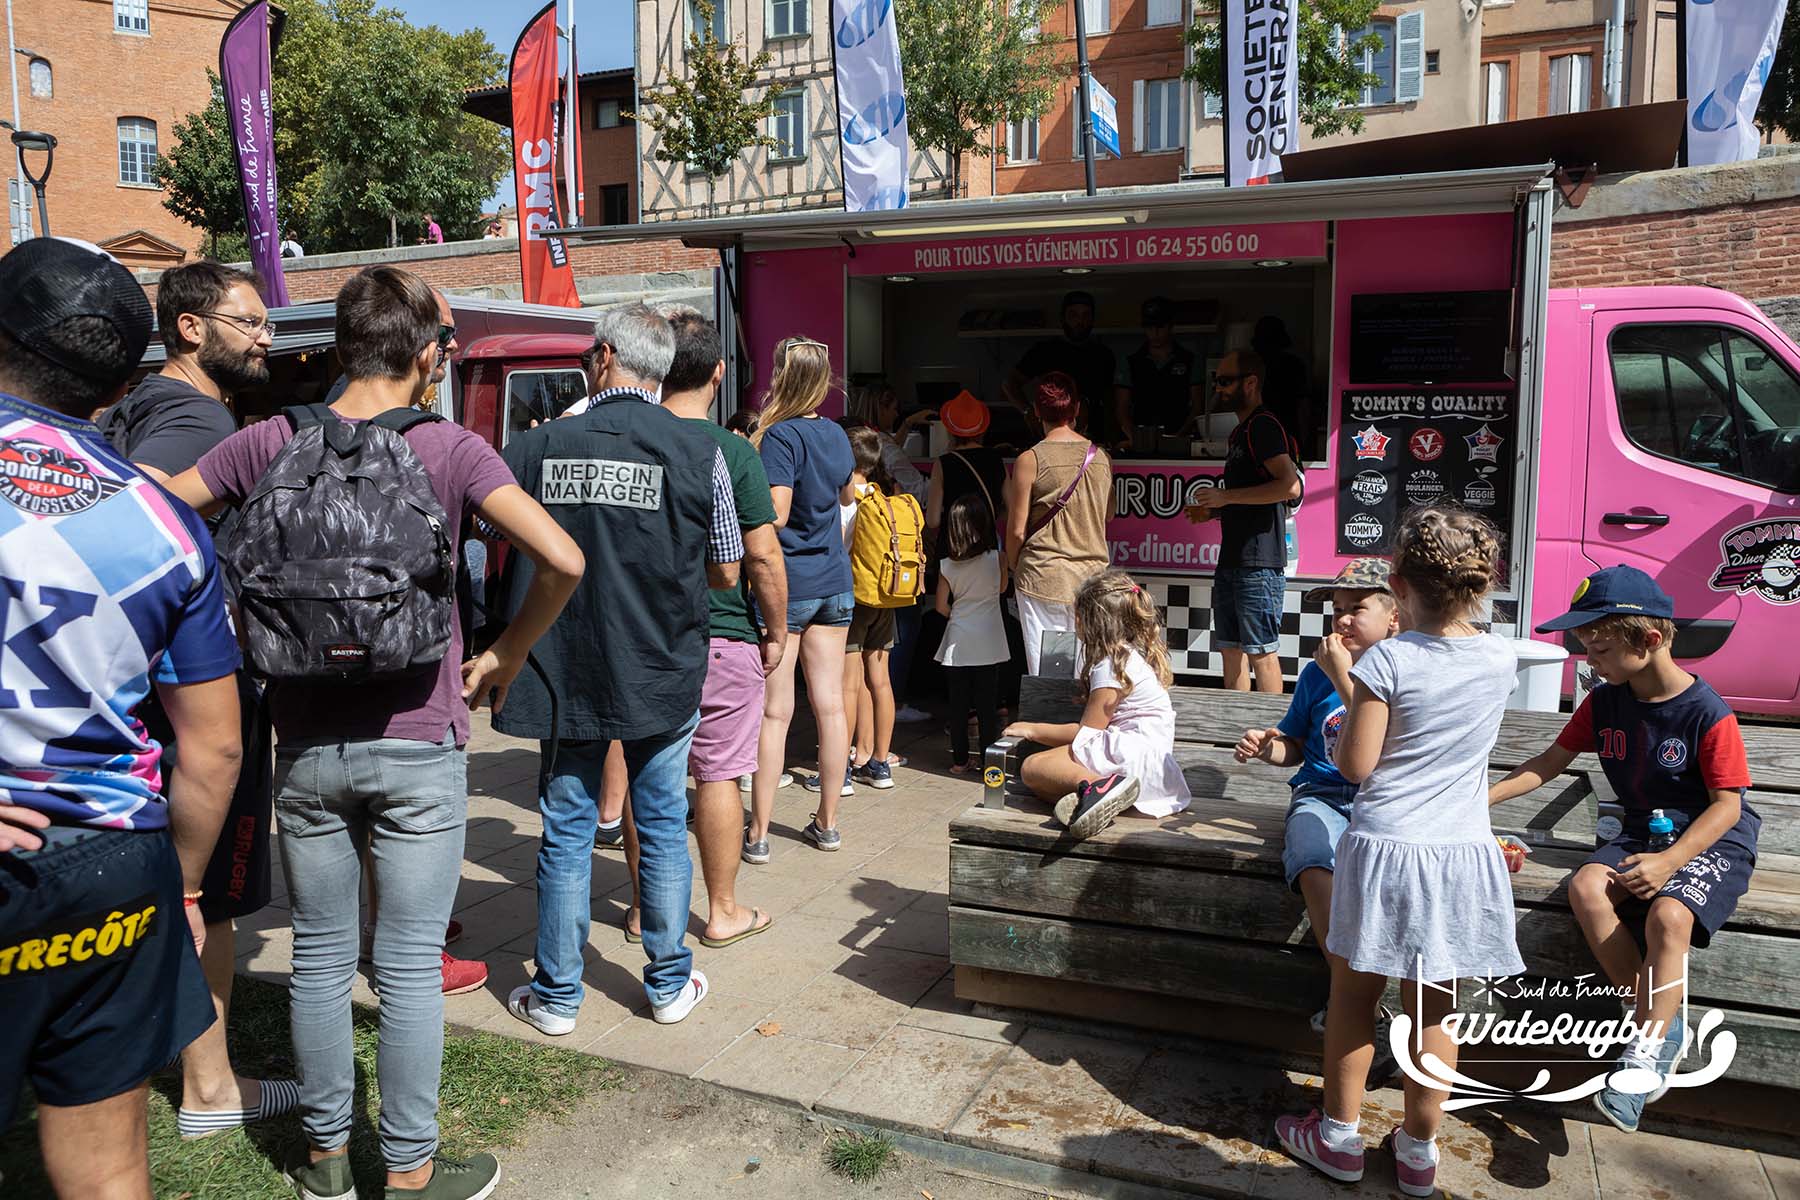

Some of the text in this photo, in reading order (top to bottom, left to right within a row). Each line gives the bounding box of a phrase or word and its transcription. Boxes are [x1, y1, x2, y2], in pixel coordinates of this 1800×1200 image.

[236, 93, 259, 157] France
[244, 156, 258, 179] de
[521, 137, 551, 241] RMC
[914, 232, 1259, 269] POUR TOUS VOS ÉVÉNEMENTS 06 24 55 06 00
[1351, 395, 1506, 412] TOMMY'S QUALITY
[1415, 433, 1436, 453] V
[551, 463, 653, 486] MEDECIN
[1410, 469, 1439, 479] PAIN
[27, 482, 58, 495] DE LA
[544, 481, 657, 506] MANAGER
[1357, 482, 1383, 494] FRAIS
[1463, 490, 1496, 499] VEGGIE
[1346, 524, 1381, 536] TOMMY'S
[1729, 552, 1766, 567] Diner
[1761, 586, 1786, 601] Since
[331, 649, 365, 657] EASTPAK
[1598, 727, 1627, 761] 10
[1685, 887, 1705, 903] HOPE
